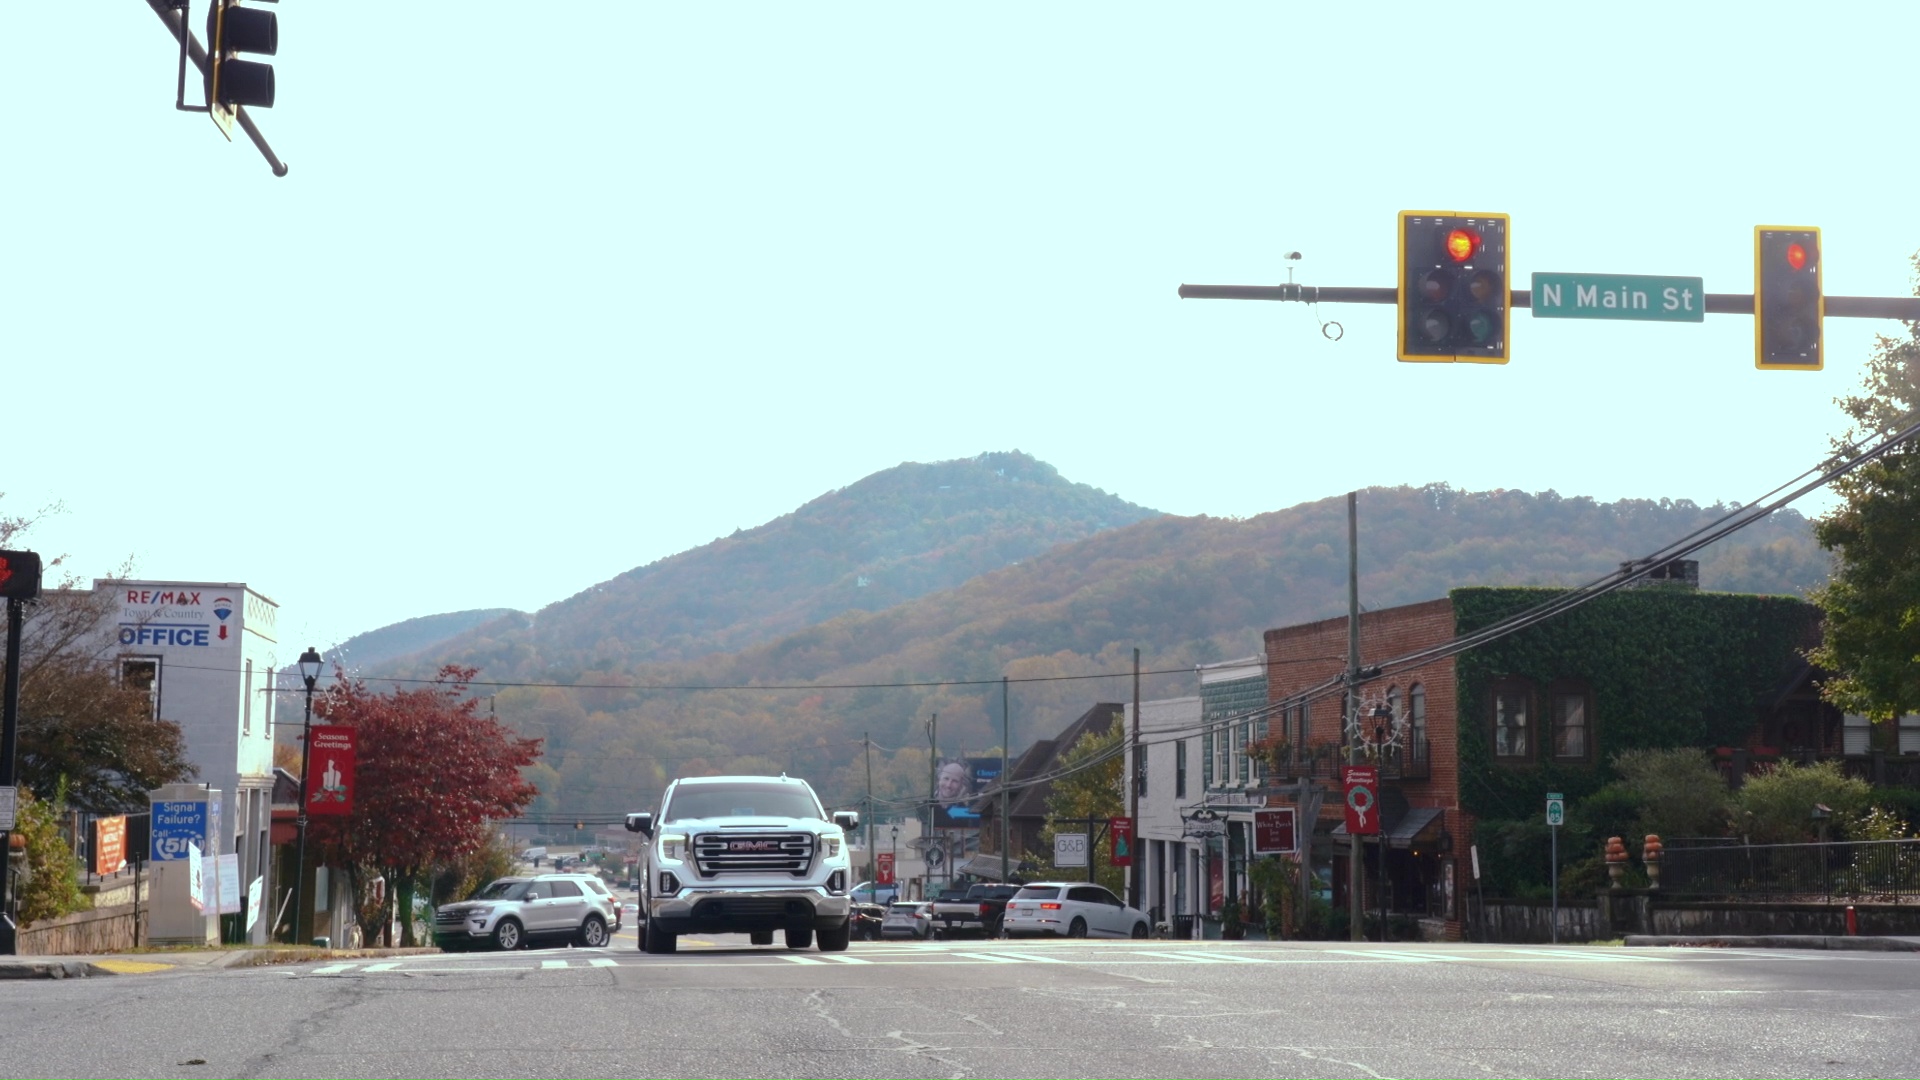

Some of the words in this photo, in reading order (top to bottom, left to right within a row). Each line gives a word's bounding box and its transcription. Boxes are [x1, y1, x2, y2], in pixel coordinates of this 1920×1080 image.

[1543, 283, 1561, 307] N
[1577, 284, 1647, 309] Main
[1662, 287, 1693, 311] St
[127, 590, 200, 605] RE/MAX
[123, 608, 150, 618] Town
[163, 609, 205, 621] Country
[118, 628, 210, 646] OFFICE
[317, 732, 348, 741] Seasons
[313, 741, 352, 750] Greetings
[163, 803, 196, 814] Signal
[157, 814, 201, 825] Failure?
[152, 829, 168, 838] Call
[729, 841, 778, 850] GMC
[1057, 839, 1083, 852] G&B
